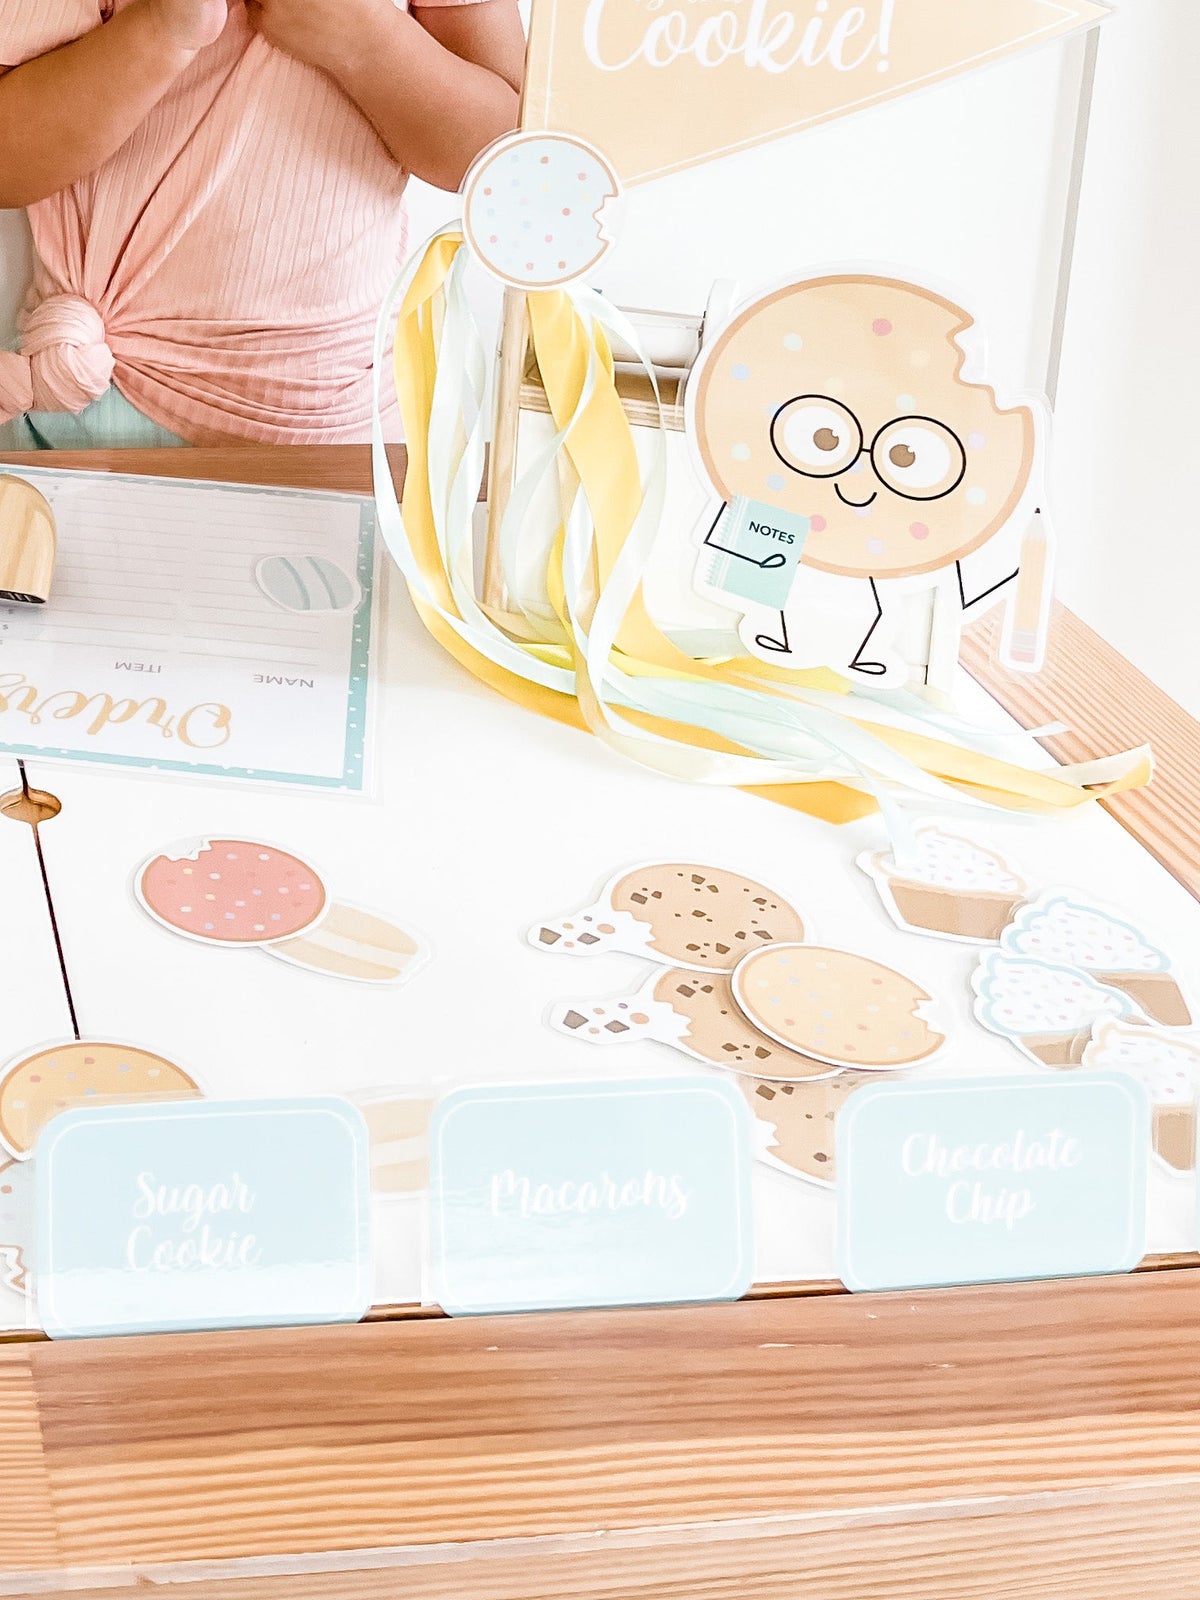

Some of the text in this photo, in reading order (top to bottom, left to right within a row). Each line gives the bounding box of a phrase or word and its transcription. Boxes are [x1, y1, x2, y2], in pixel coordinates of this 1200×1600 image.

[748, 521, 796, 545] NOTES
[114, 661, 162, 674] ITEM
[253, 673, 315, 689] NAME
[901, 1128, 1083, 1177] Chocolate
[131, 1170, 257, 1233] Sugar
[490, 1168, 693, 1220] Macarons
[945, 1180, 1037, 1231] Chip
[125, 1223, 264, 1271] Cookie
